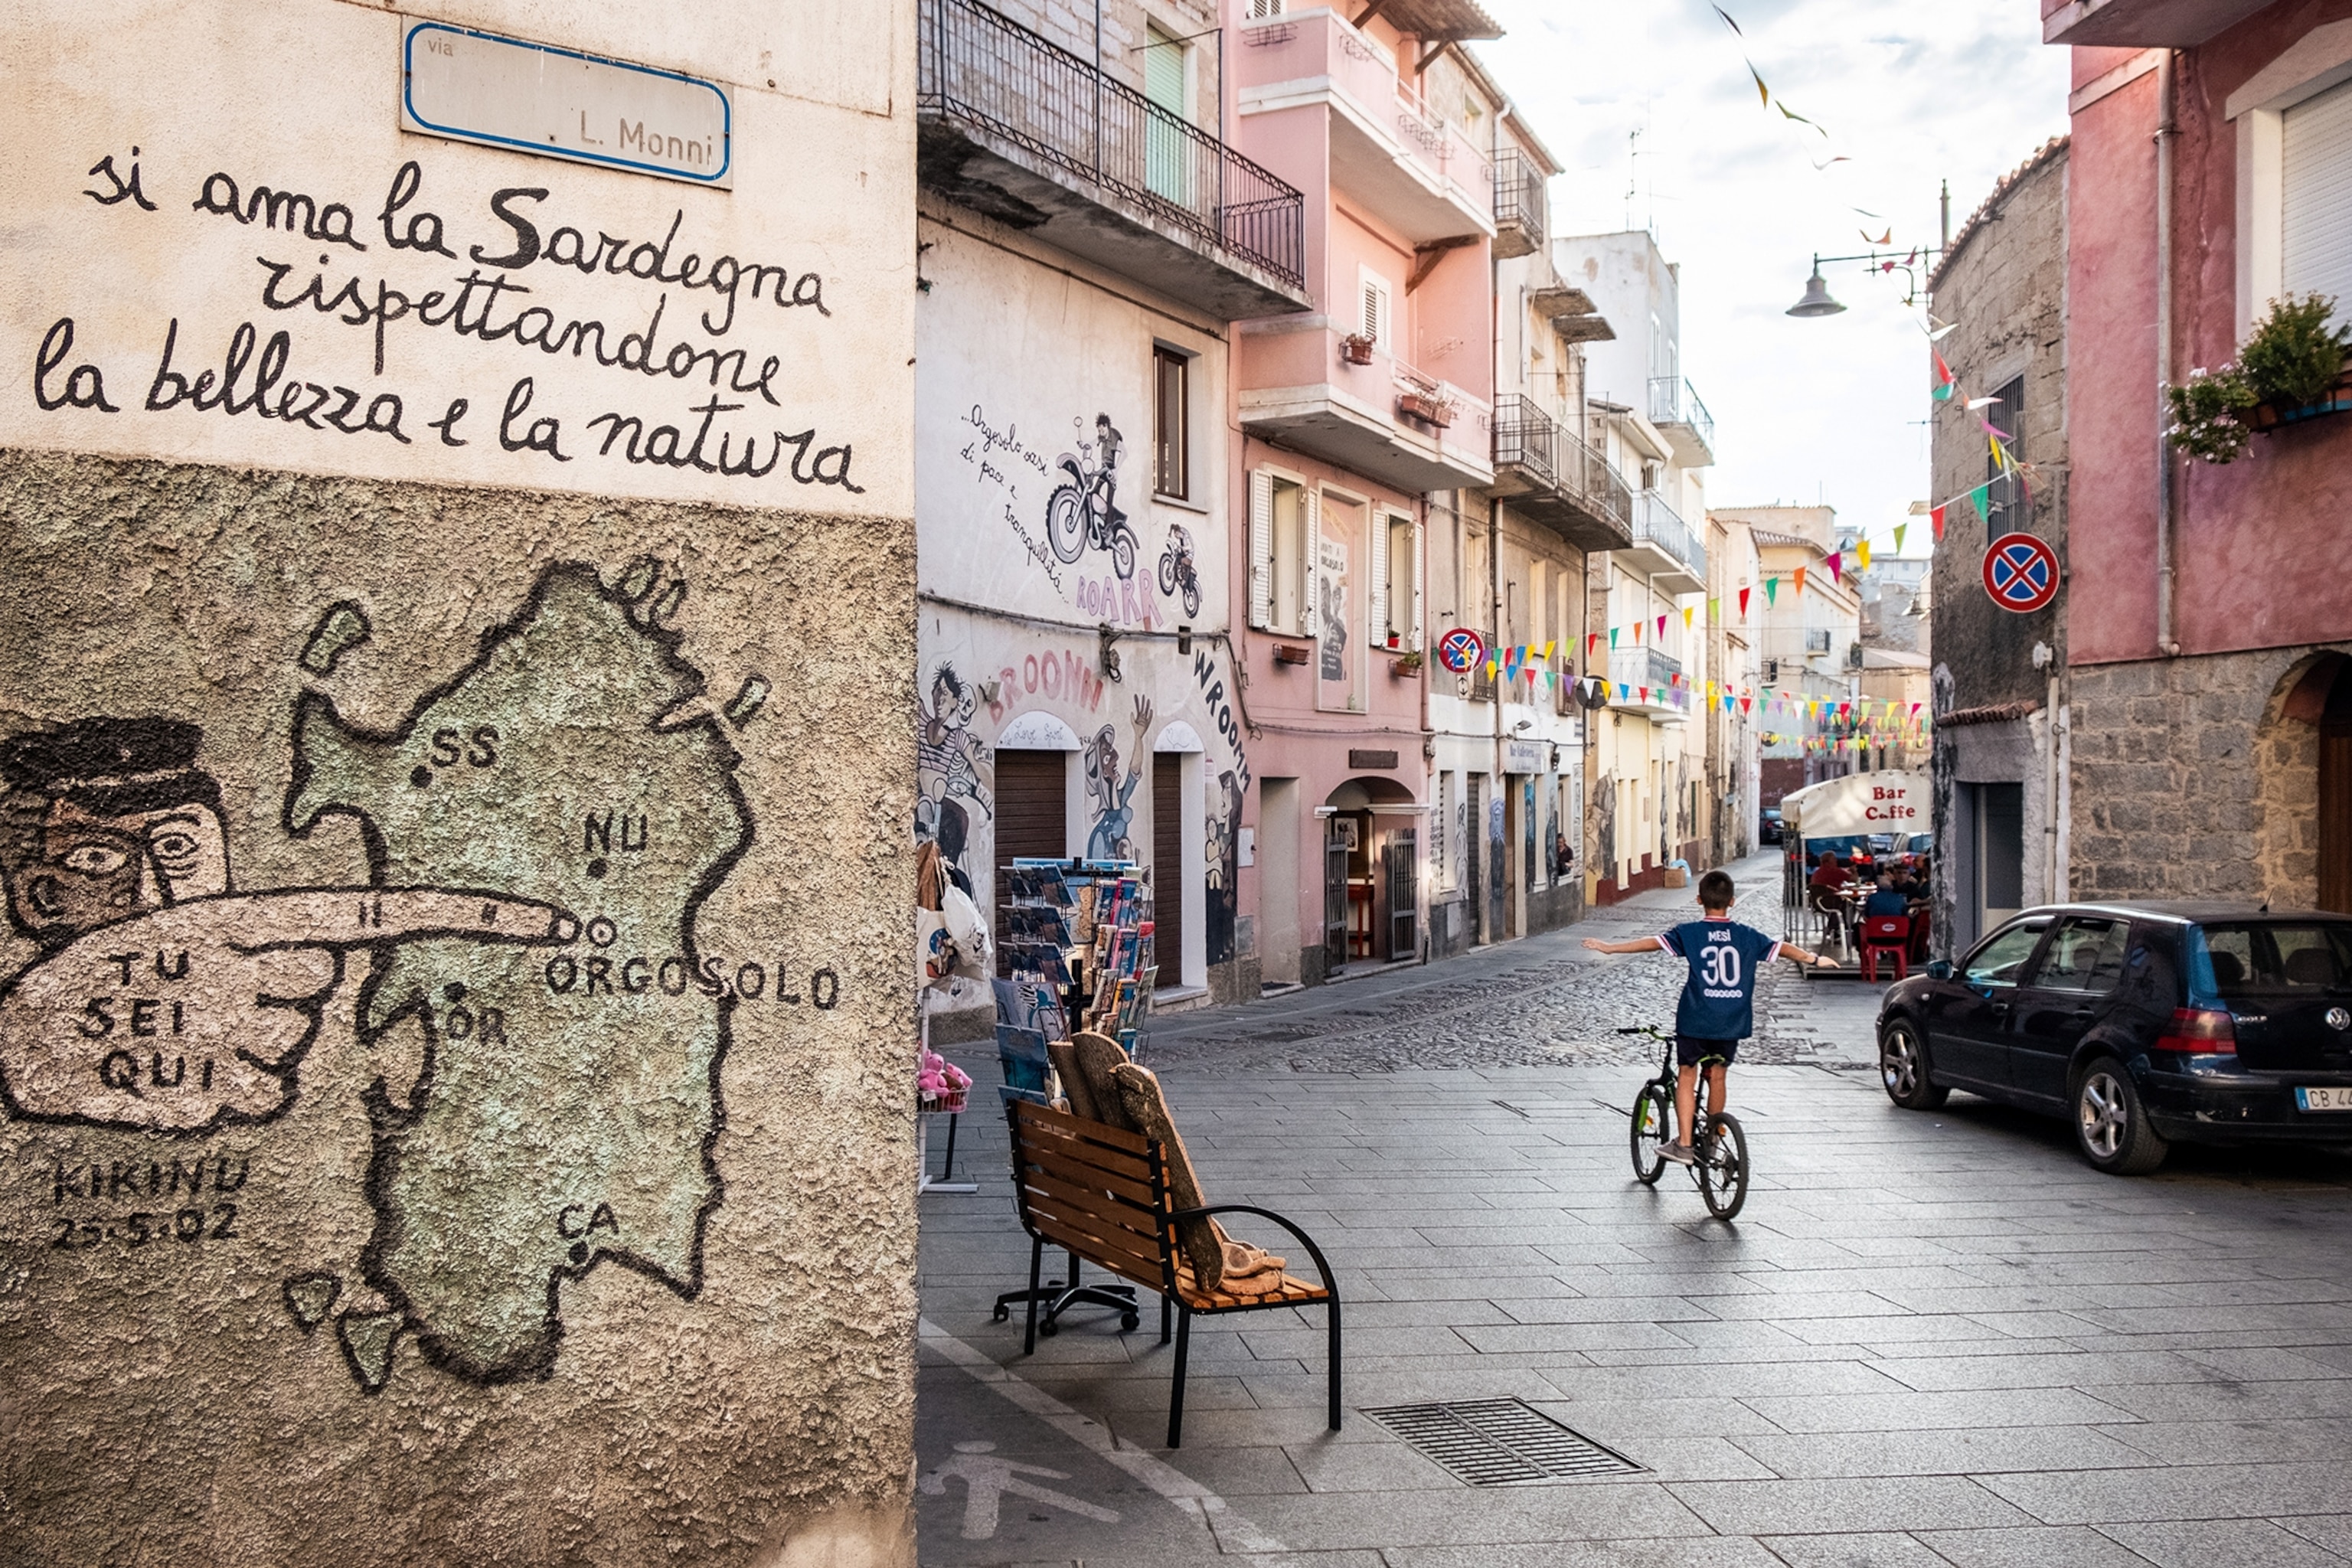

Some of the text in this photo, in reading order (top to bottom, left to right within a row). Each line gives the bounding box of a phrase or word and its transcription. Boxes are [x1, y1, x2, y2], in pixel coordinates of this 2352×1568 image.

[427, 38, 454, 57] via
[580, 110, 713, 166] L. Monni
[83, 145, 832, 337] si ama la Sardegna
[257, 256, 781, 407] rispettandone
[34, 318, 866, 494] la bellezza e la natura
[960, 442, 1018, 500] di pace e
[1024, 451, 1049, 477] oasi
[1076, 568, 1165, 632] ROARR
[430, 726, 500, 767] SS
[1873, 786, 1906, 801] Bar
[583, 811, 648, 854] NU
[109, 951, 191, 988] TU
[544, 956, 840, 1011] ORGOSOLO
[1700, 946, 1741, 988] 30
[79, 997, 184, 1040] SEI
[446, 1008, 508, 1046] OR
[100, 1050, 214, 1101] QUI
[2309, 1089, 2331, 1108] CB
[557, 1204, 619, 1240] CA
